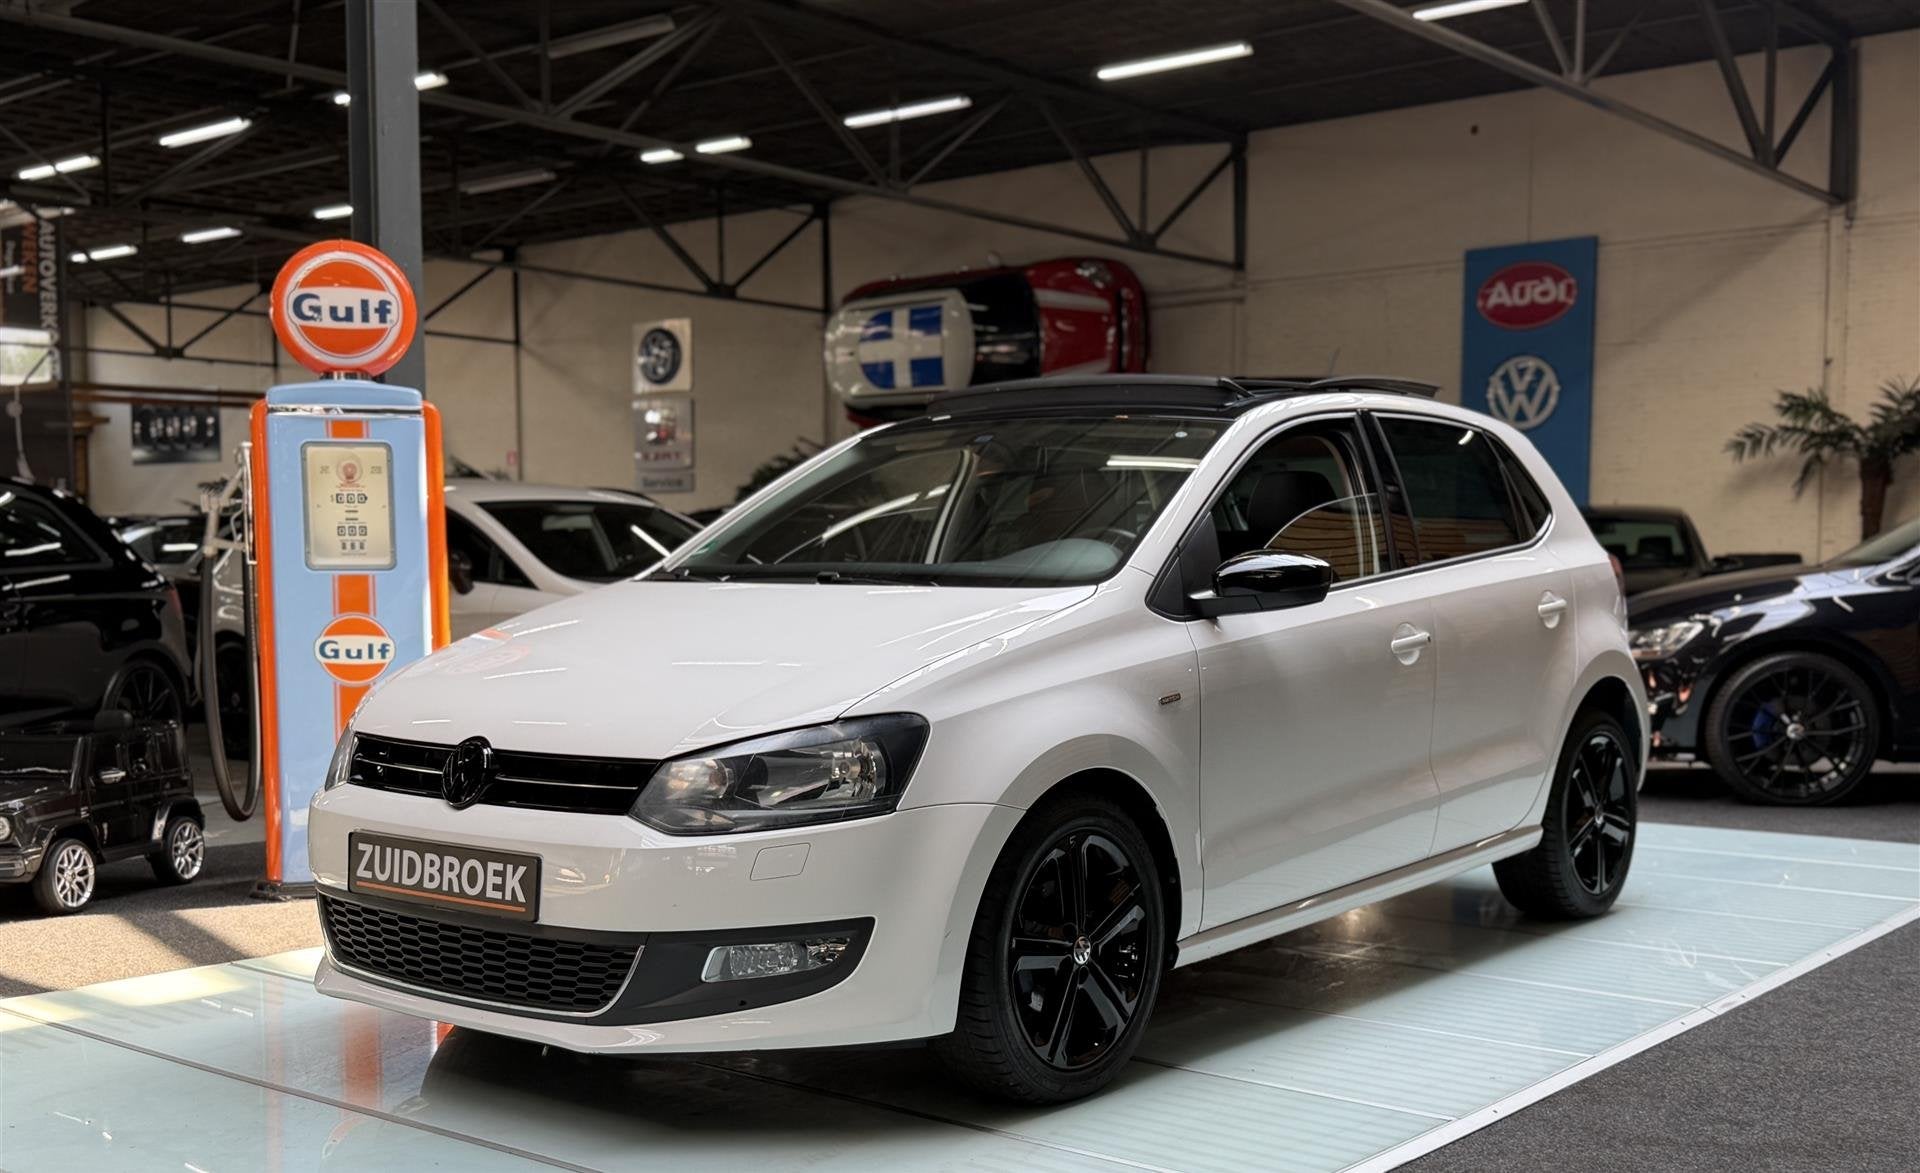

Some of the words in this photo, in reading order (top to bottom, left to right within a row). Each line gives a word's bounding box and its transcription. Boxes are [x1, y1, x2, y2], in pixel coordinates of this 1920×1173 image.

[292, 293, 393, 324] Gulf
[319, 639, 391, 660] Gulf
[356, 842, 527, 903] ZUIDBROEK
